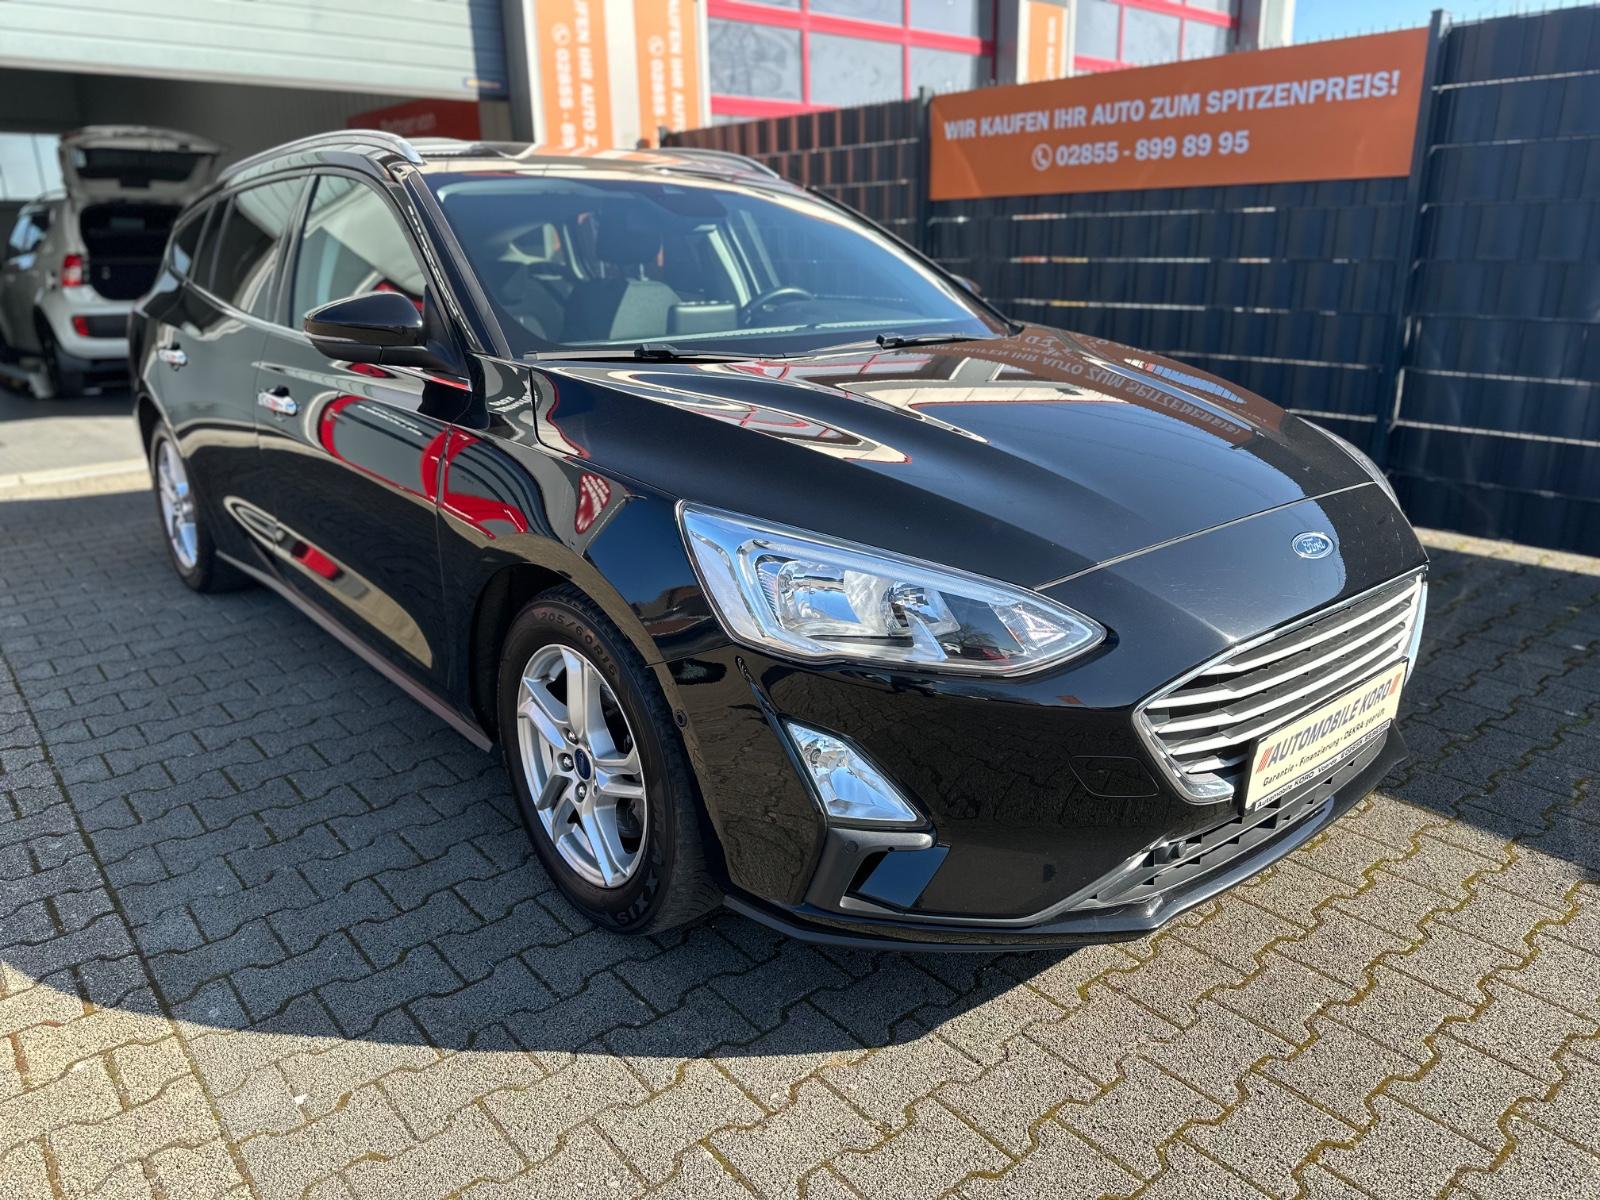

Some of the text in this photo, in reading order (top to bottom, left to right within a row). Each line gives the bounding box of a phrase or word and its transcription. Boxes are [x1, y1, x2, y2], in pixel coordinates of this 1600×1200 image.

[944, 70, 1401, 141] WIR KAUFEN IHR AUTO ZUM SPITZENPREIS!
[1055, 141, 1119, 167] 02855
[1134, 136, 1177, 161] 899
[1181, 132, 1213, 158] 89
[1218, 130, 1250, 155] 95
[1267, 697, 1361, 768] AUTOMOBILE
[1358, 678, 1392, 717] KORO
[1263, 765, 1294, 787] Garantie
[1299, 738, 1340, 767] Finanzierung
